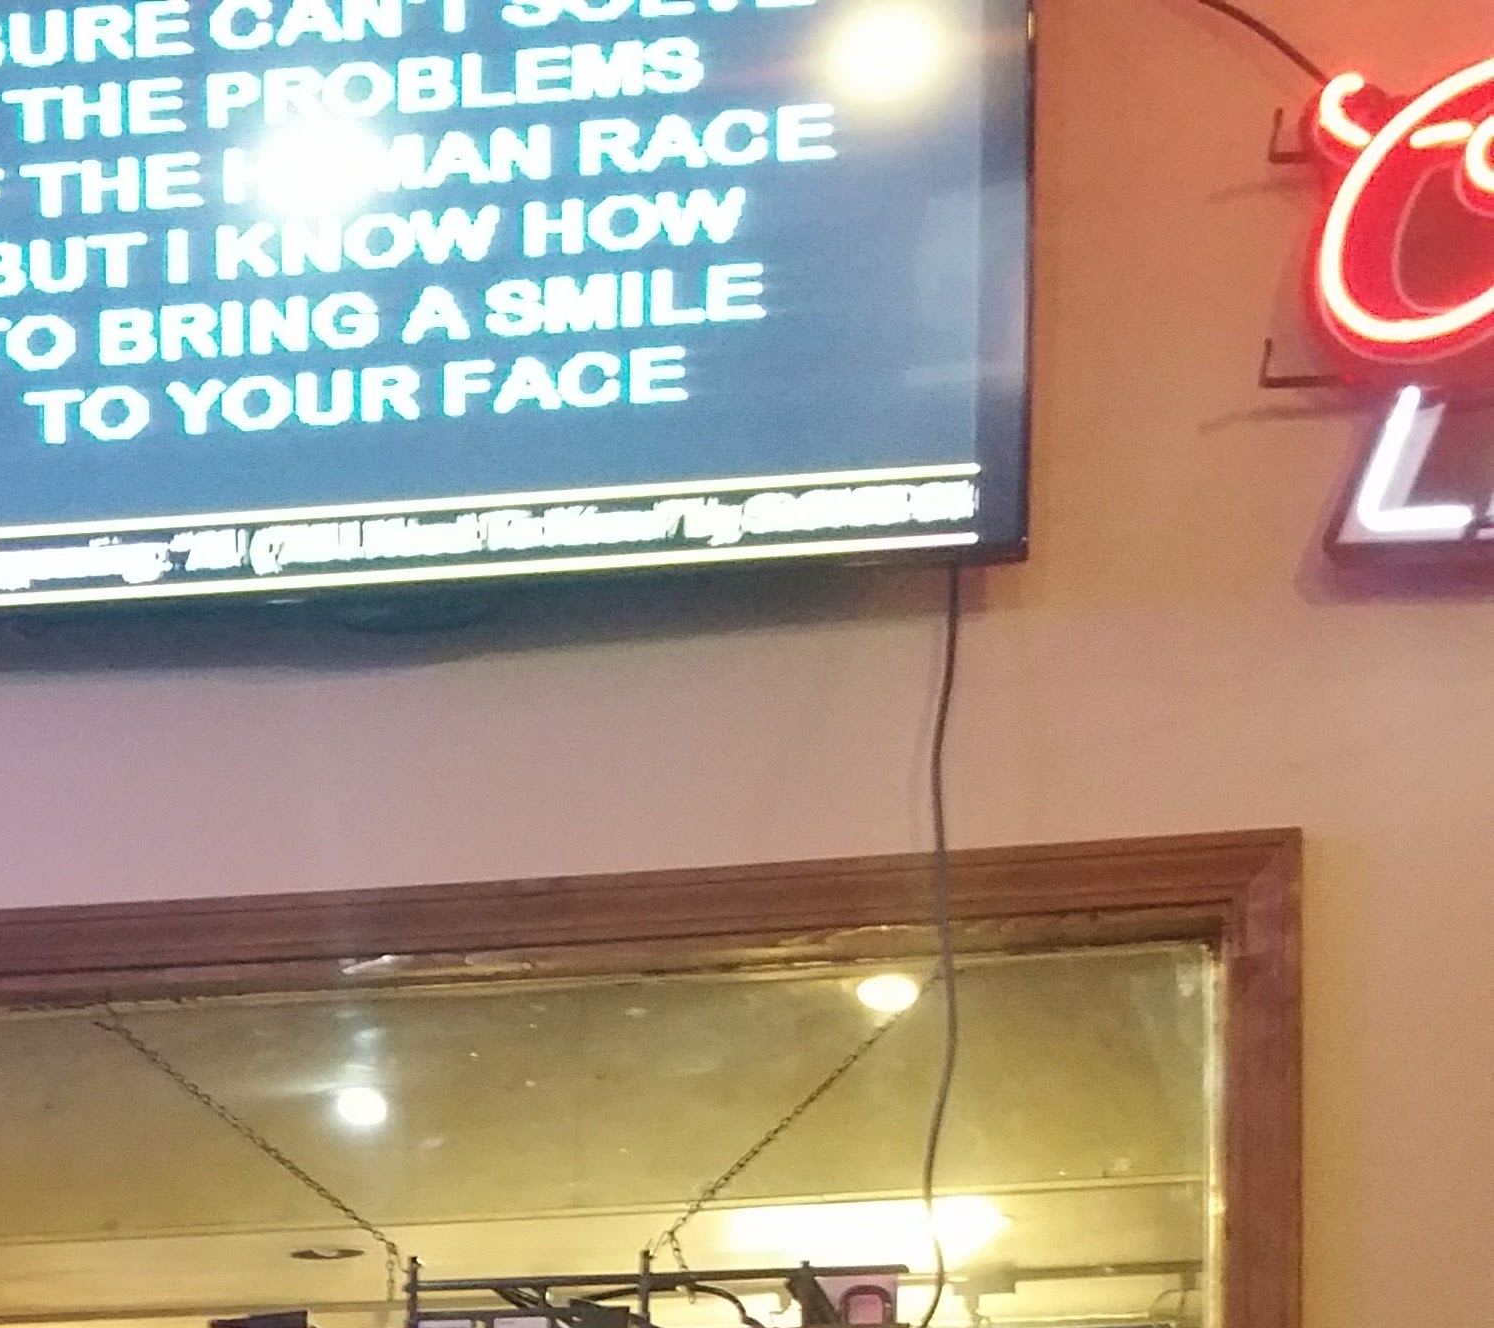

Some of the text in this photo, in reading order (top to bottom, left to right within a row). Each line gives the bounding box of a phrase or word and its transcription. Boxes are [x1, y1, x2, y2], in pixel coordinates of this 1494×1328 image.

[3, 37, 705, 144] THE PROBLEMS
[20, 151, 205, 219] THE
[580, 103, 838, 176] RACE
[167, 229, 192, 285] I
[215, 204, 500, 280] KNOW
[523, 188, 747, 259] HOW
[99, 292, 381, 367] BRING
[402, 284, 471, 346] A
[485, 261, 767, 337] SMILE
[24, 344, 689, 445] TO YOUR FACE
